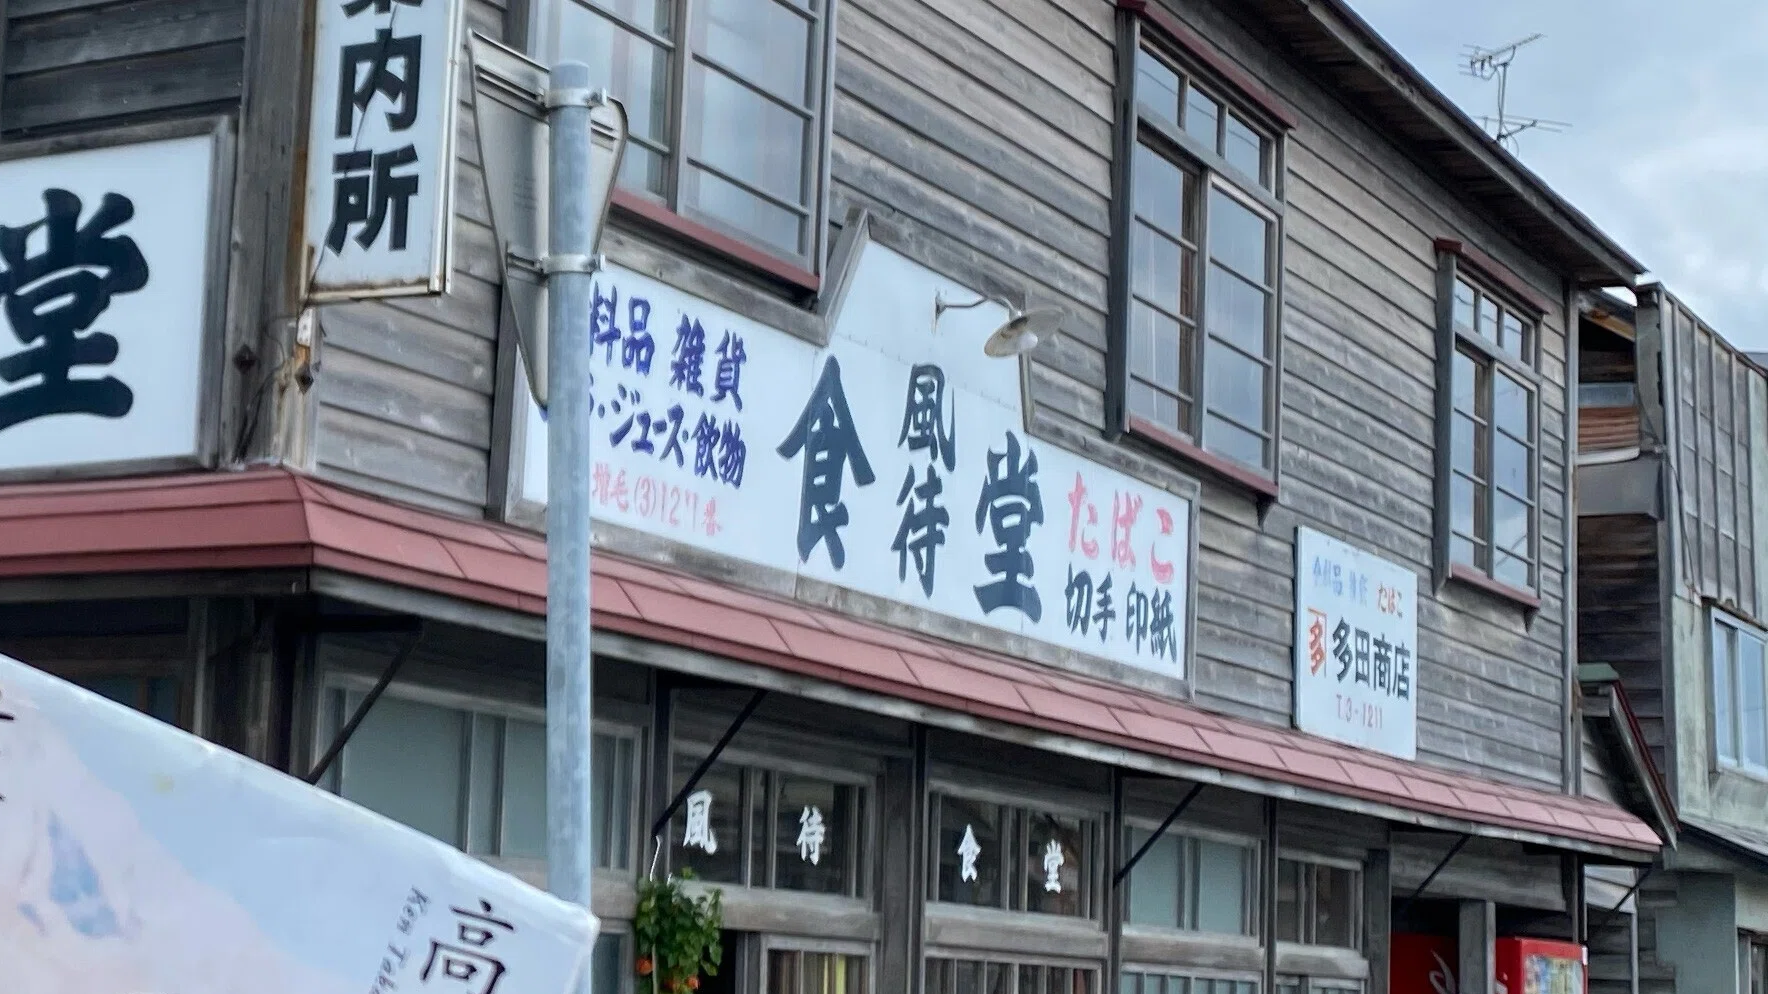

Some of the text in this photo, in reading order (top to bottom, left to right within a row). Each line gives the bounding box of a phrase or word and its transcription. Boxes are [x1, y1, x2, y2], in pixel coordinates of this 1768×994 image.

[1068, 471, 1175, 584] たばこ
[1333, 616, 1411, 700] 多田商店
[398, 886, 429, 936] Ken
